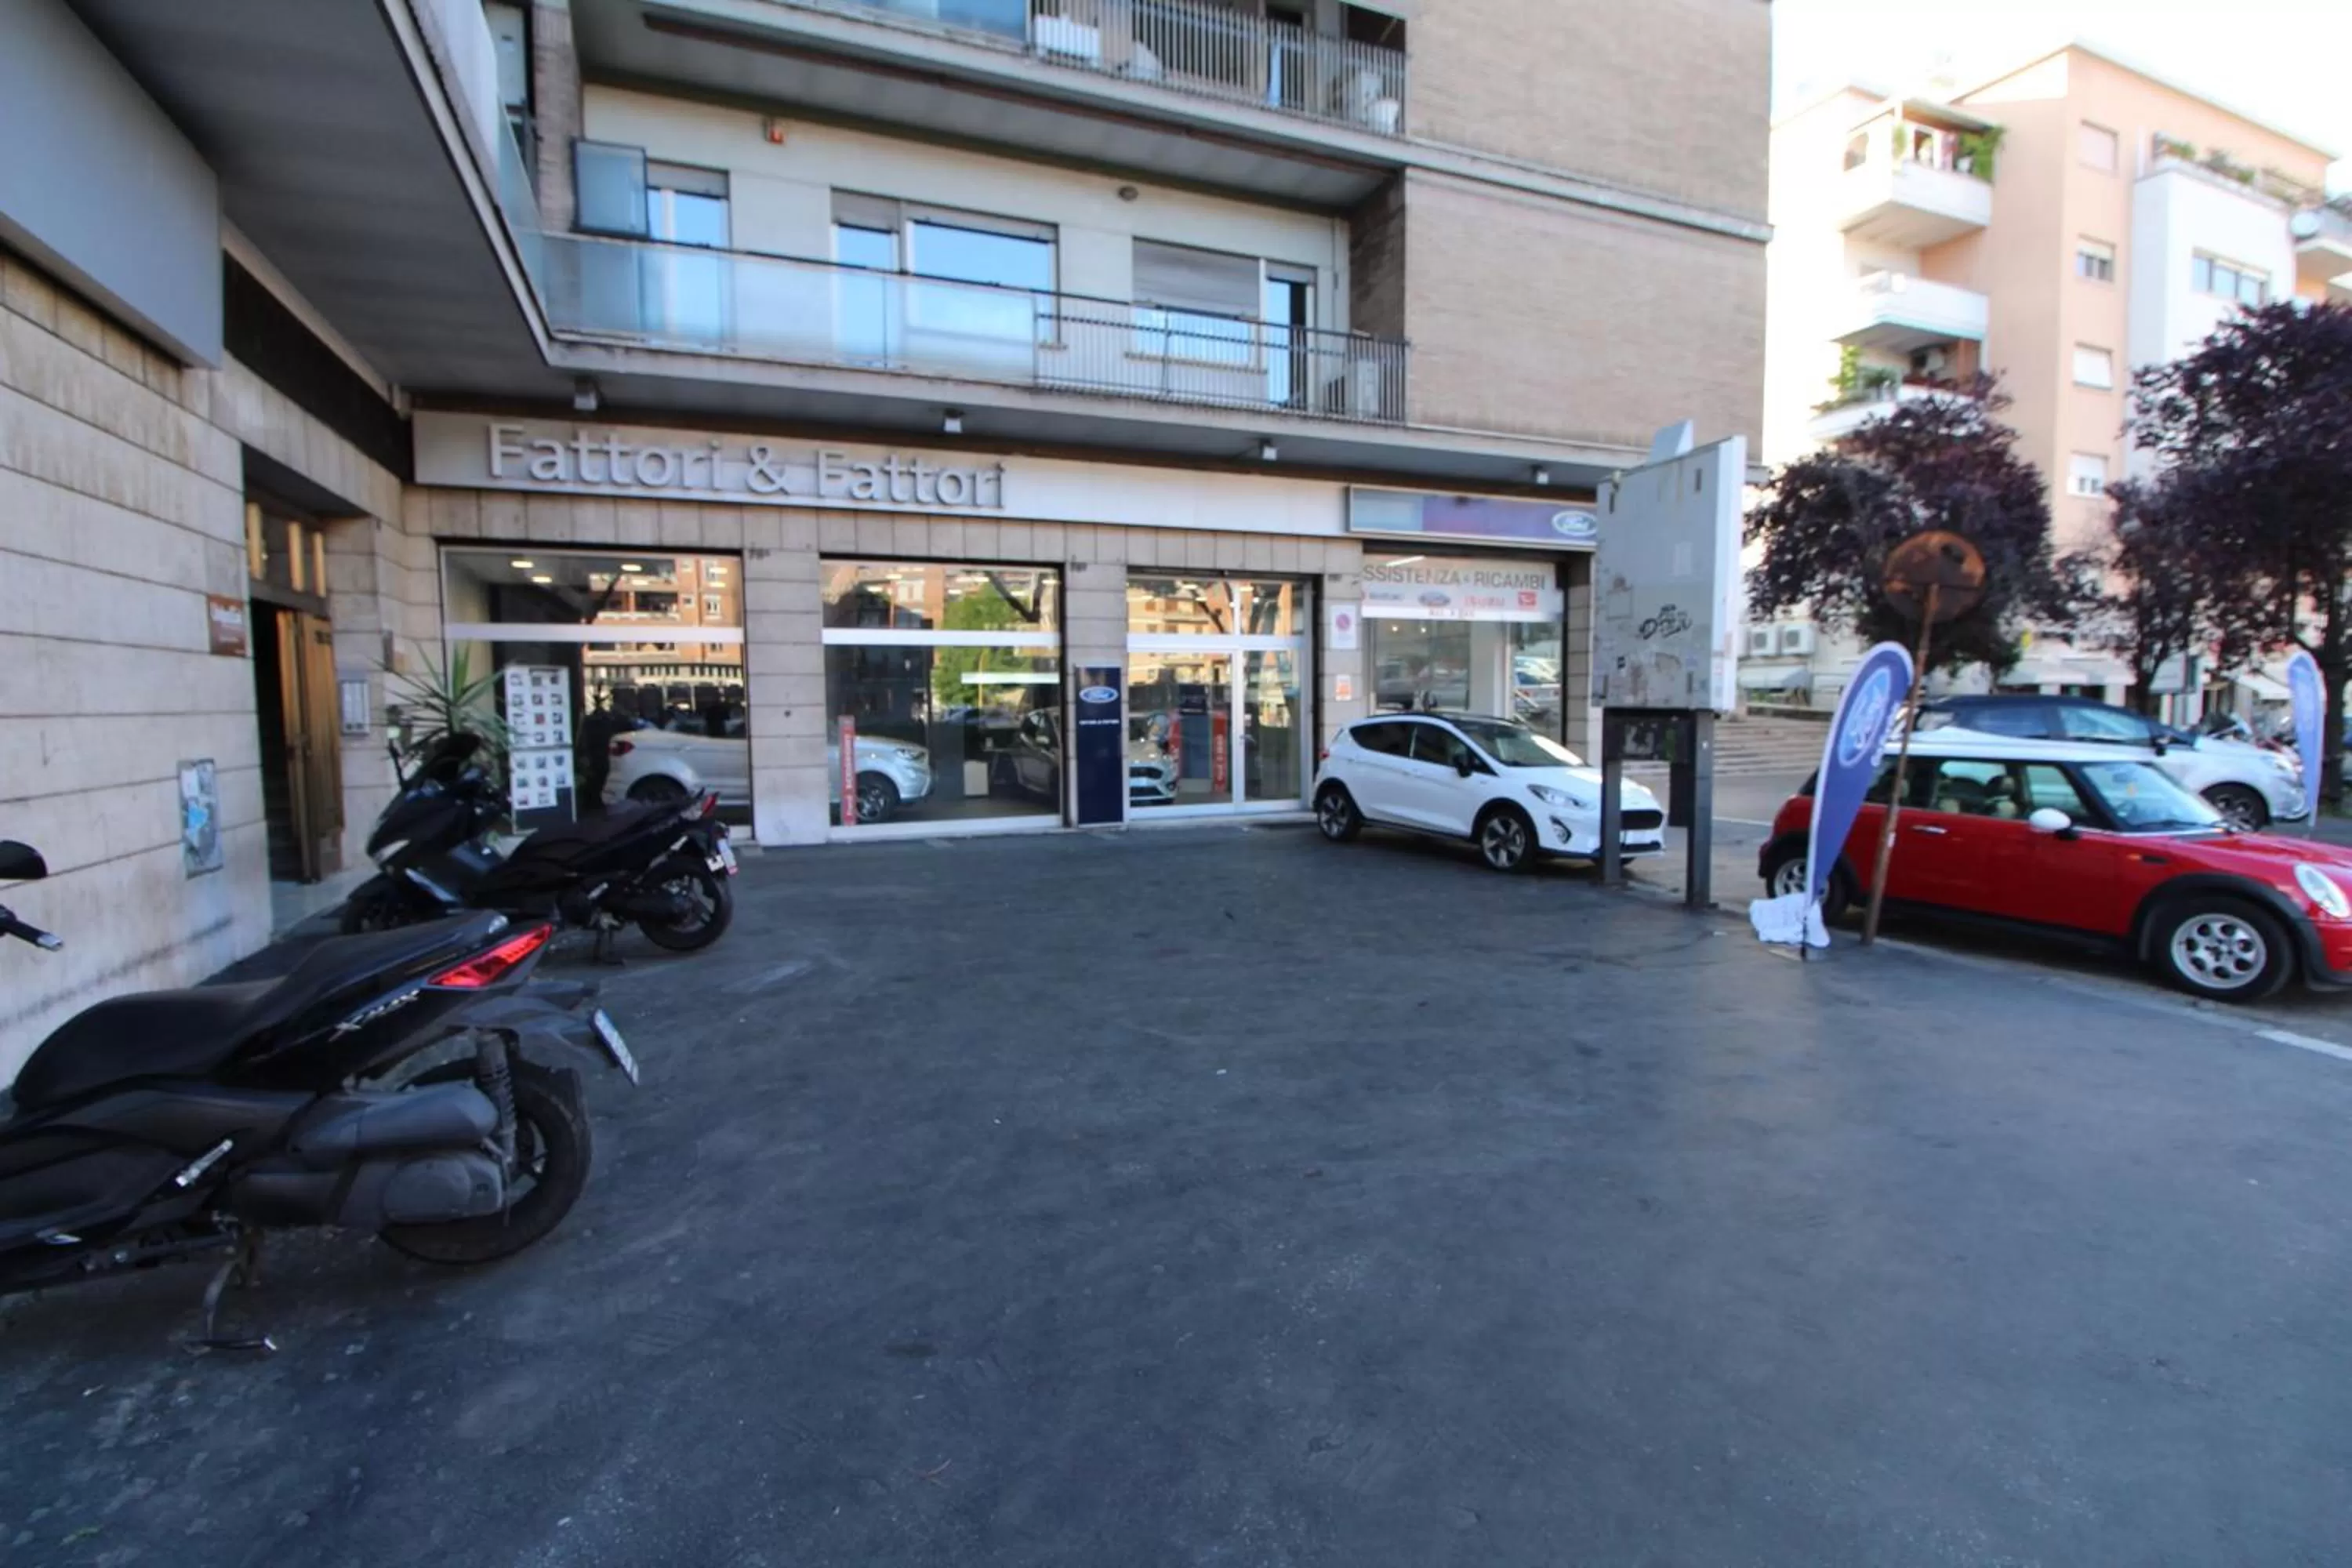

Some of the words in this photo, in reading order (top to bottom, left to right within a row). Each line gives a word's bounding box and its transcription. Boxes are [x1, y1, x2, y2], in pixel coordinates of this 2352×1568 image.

[488, 423, 723, 490] Fattori
[746, 445, 789, 495] &
[817, 448, 1005, 510] Fattori
[1363, 564, 1461, 586] SSISTENZA
[1473, 570, 1546, 590] RICAMBI
